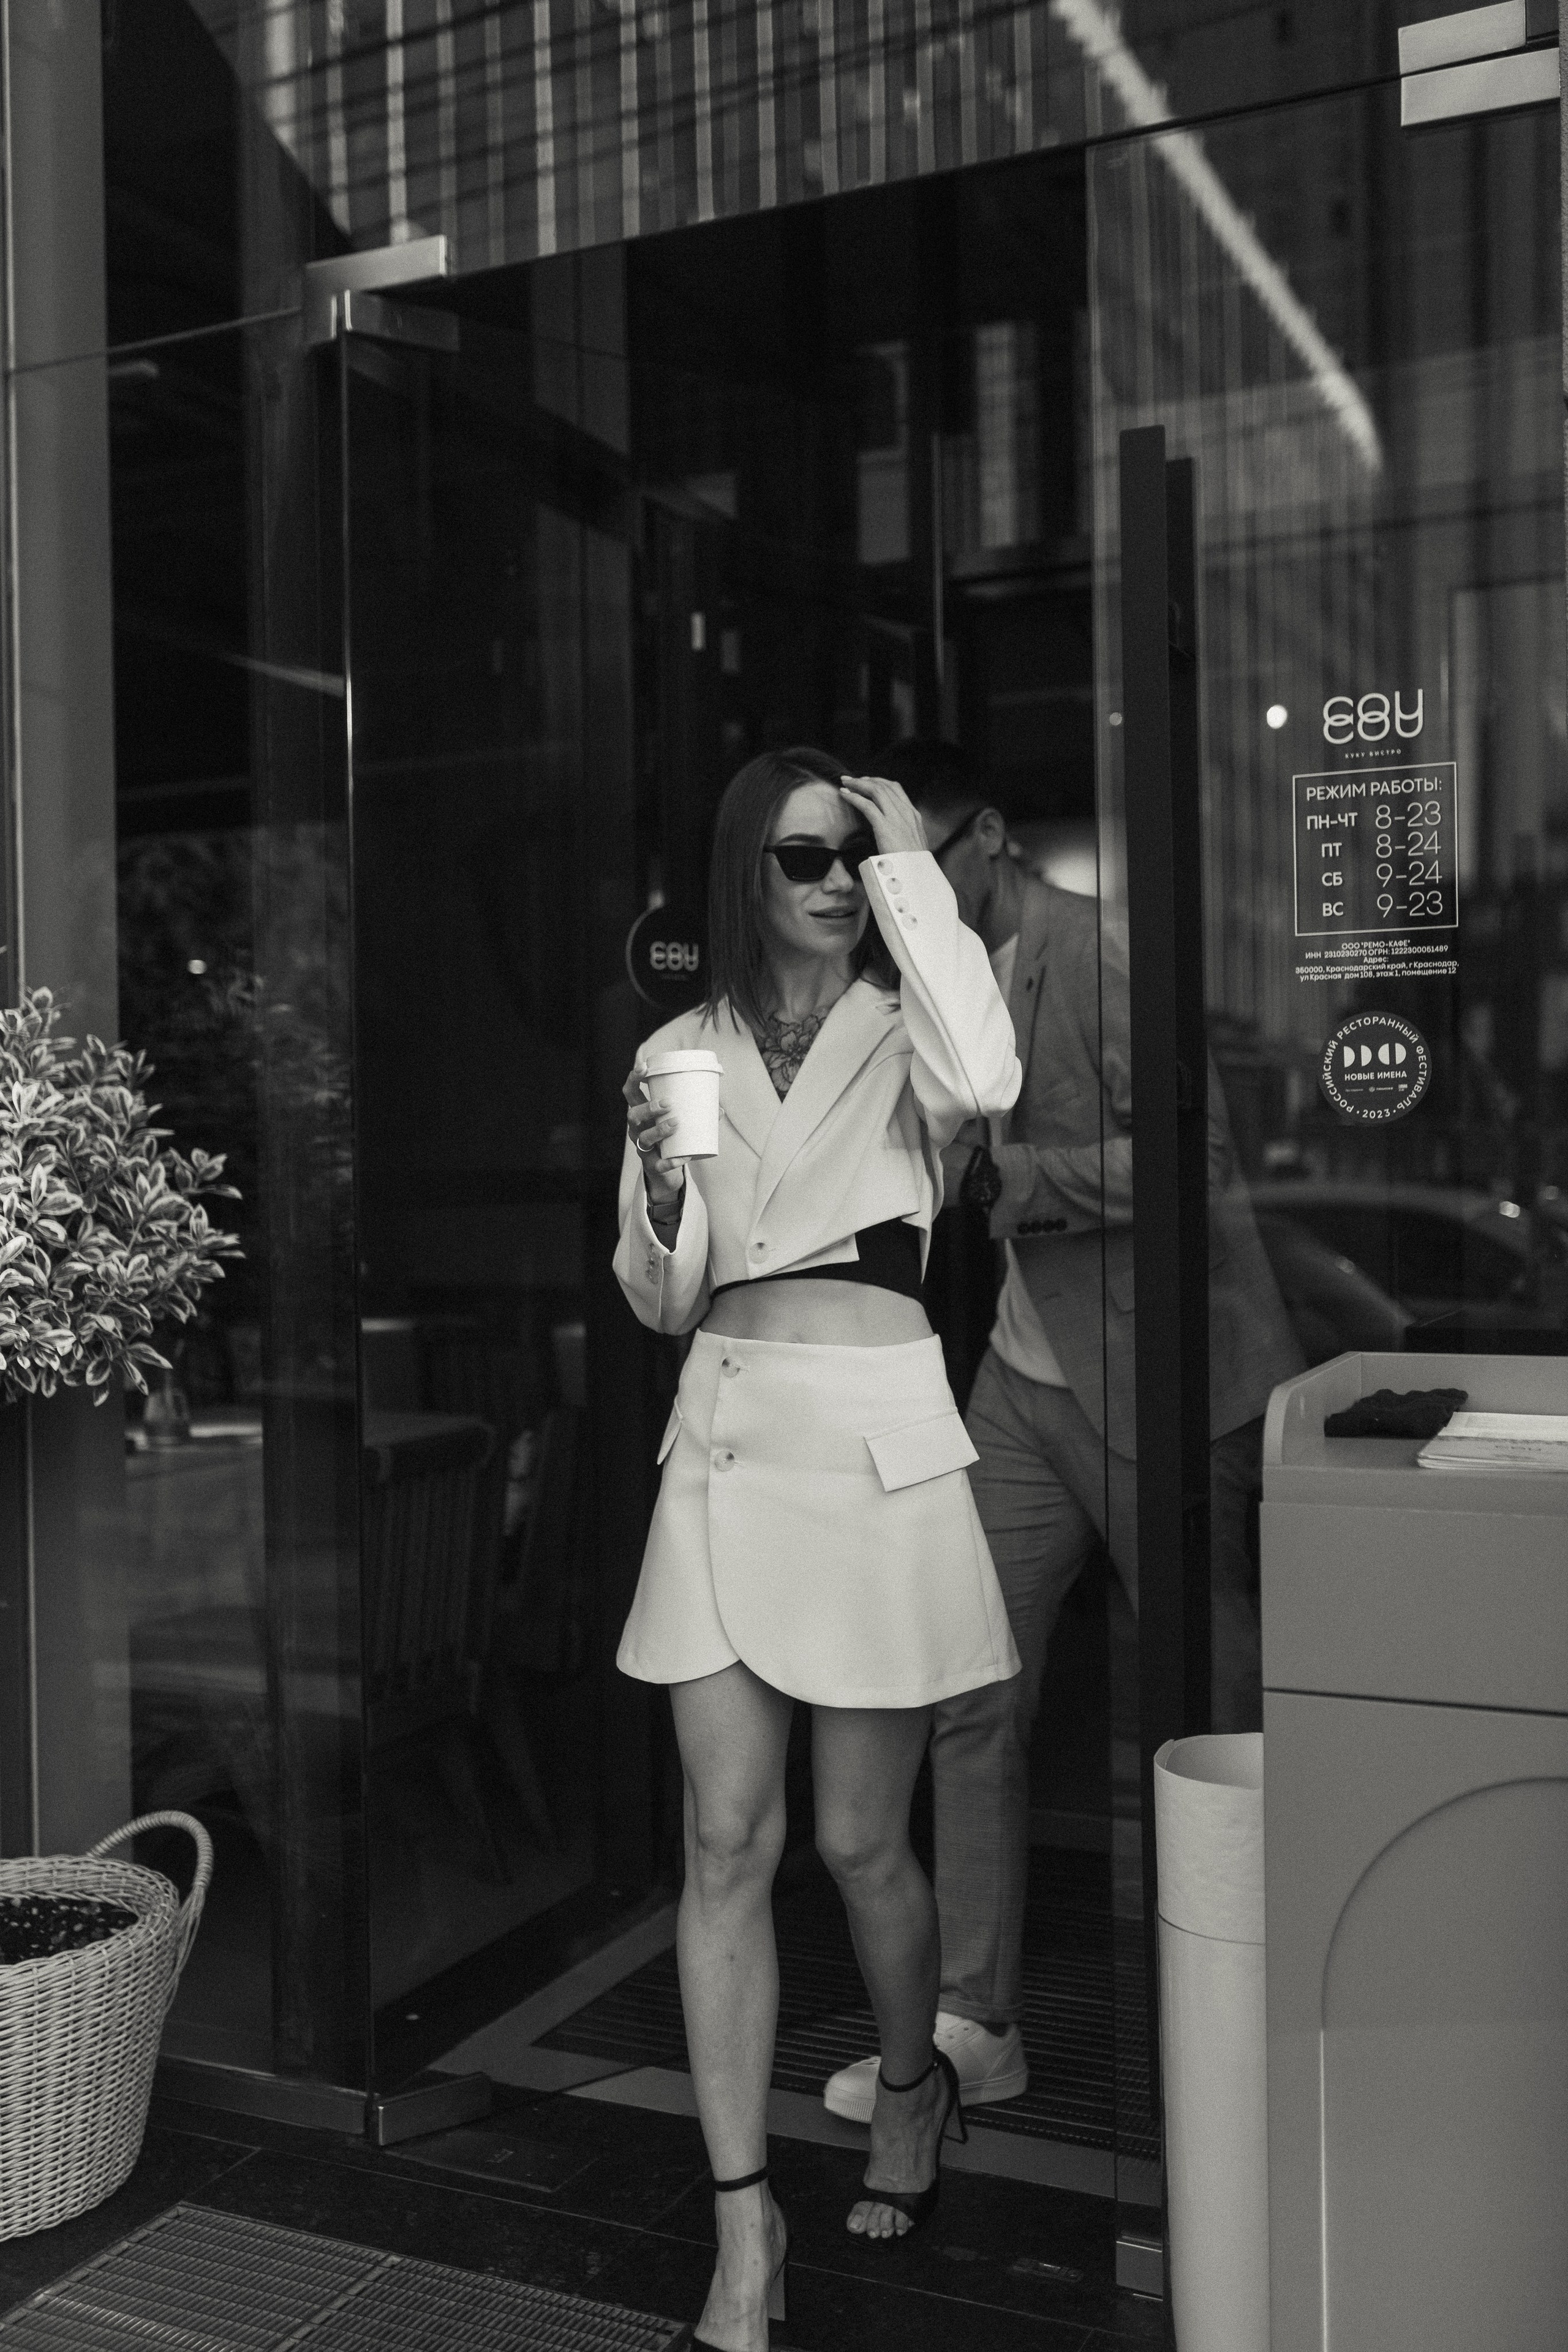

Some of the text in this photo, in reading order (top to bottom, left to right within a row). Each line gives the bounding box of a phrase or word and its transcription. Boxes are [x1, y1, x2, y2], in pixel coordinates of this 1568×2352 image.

[1306, 777, 1442, 801] РЕЖИМ РАБОТЫ:
[1306, 801, 1441, 830] ПН-ЧТ 8-23
[1321, 830, 1441, 858] ПТ 8-24
[1322, 859, 1442, 888] СБ 9-24
[1322, 890, 1443, 918] ВС 9-23
[1368, 948, 1390, 956] ОГРН:
[1310, 973, 1341, 982] Красная
[1326, 963, 1385, 974] Краснодарский
[1387, 961, 1408, 970] край,
[1414, 960, 1459, 970] Краснодар,
[1322, 1016, 1427, 1113] РОССИЙСКИЙ РЕСТОРАННЫЙ ФЕСТИВАЛЬ
[1344, 1070, 1408, 1081] НОВЫЕ ИМЕНА
[1362, 1108, 1390, 1119] 2023
